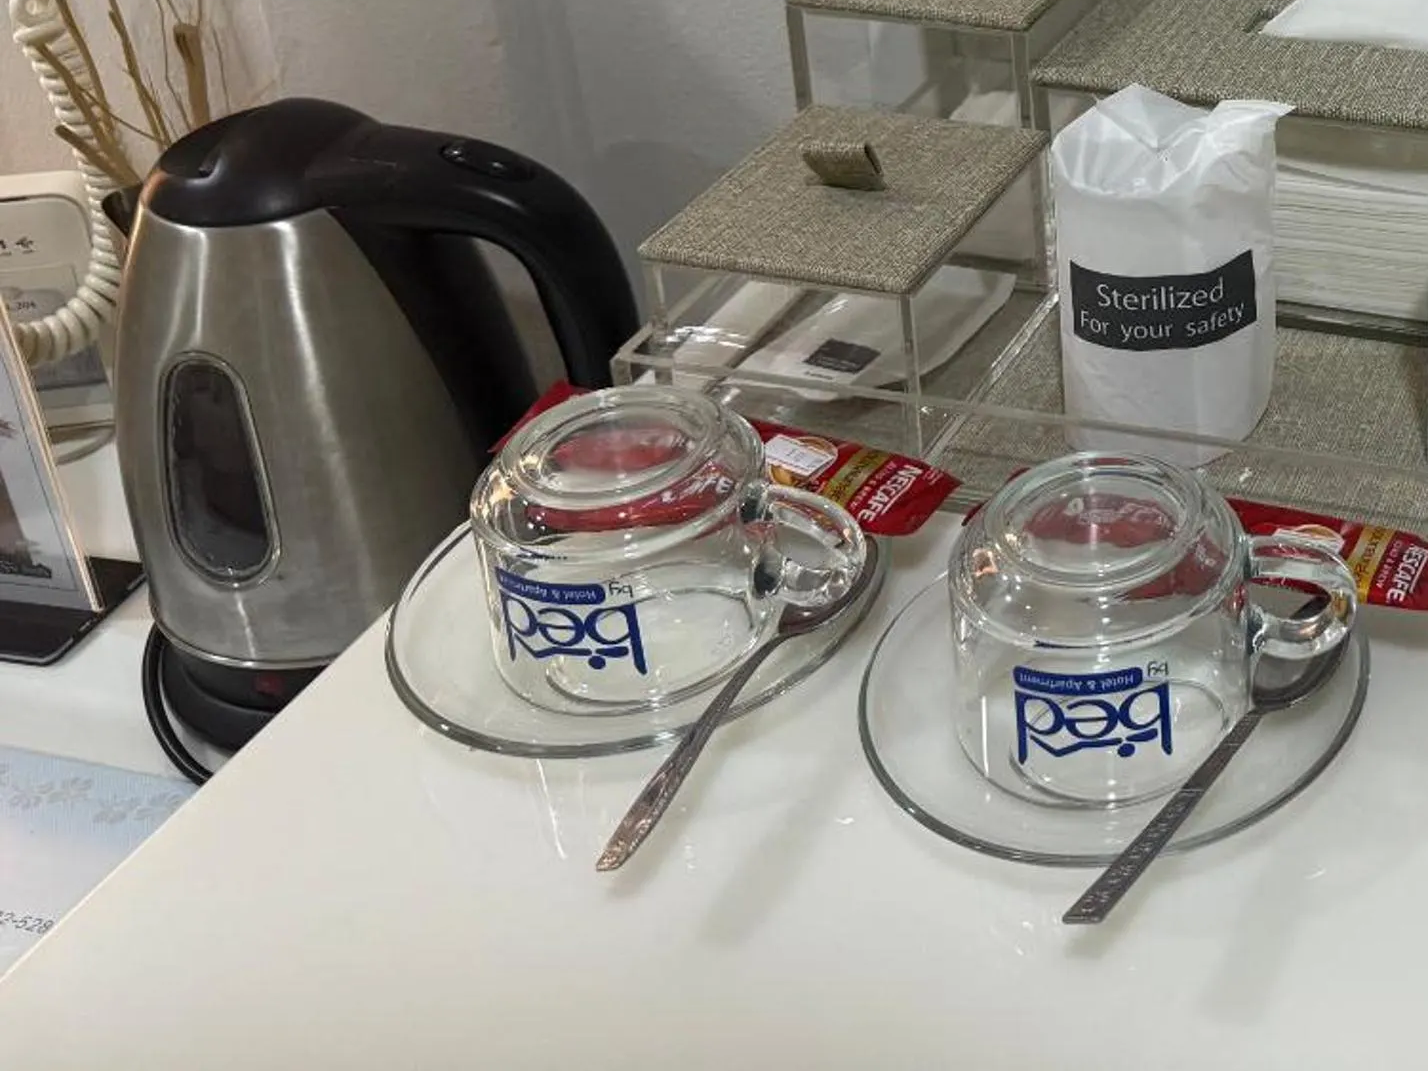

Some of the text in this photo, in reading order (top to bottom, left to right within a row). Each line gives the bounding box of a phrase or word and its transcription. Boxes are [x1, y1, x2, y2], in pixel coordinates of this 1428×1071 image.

[1096, 277, 1224, 311] Sterilized
[1080, 303, 1245, 342] For your safety
[498, 589, 648, 675] bed
[1087, 680, 1097, 691] &
[1100, 673, 1134, 692] Hotel
[1015, 681, 1173, 765] bed
[0, 910, 54, 934] 2-528
